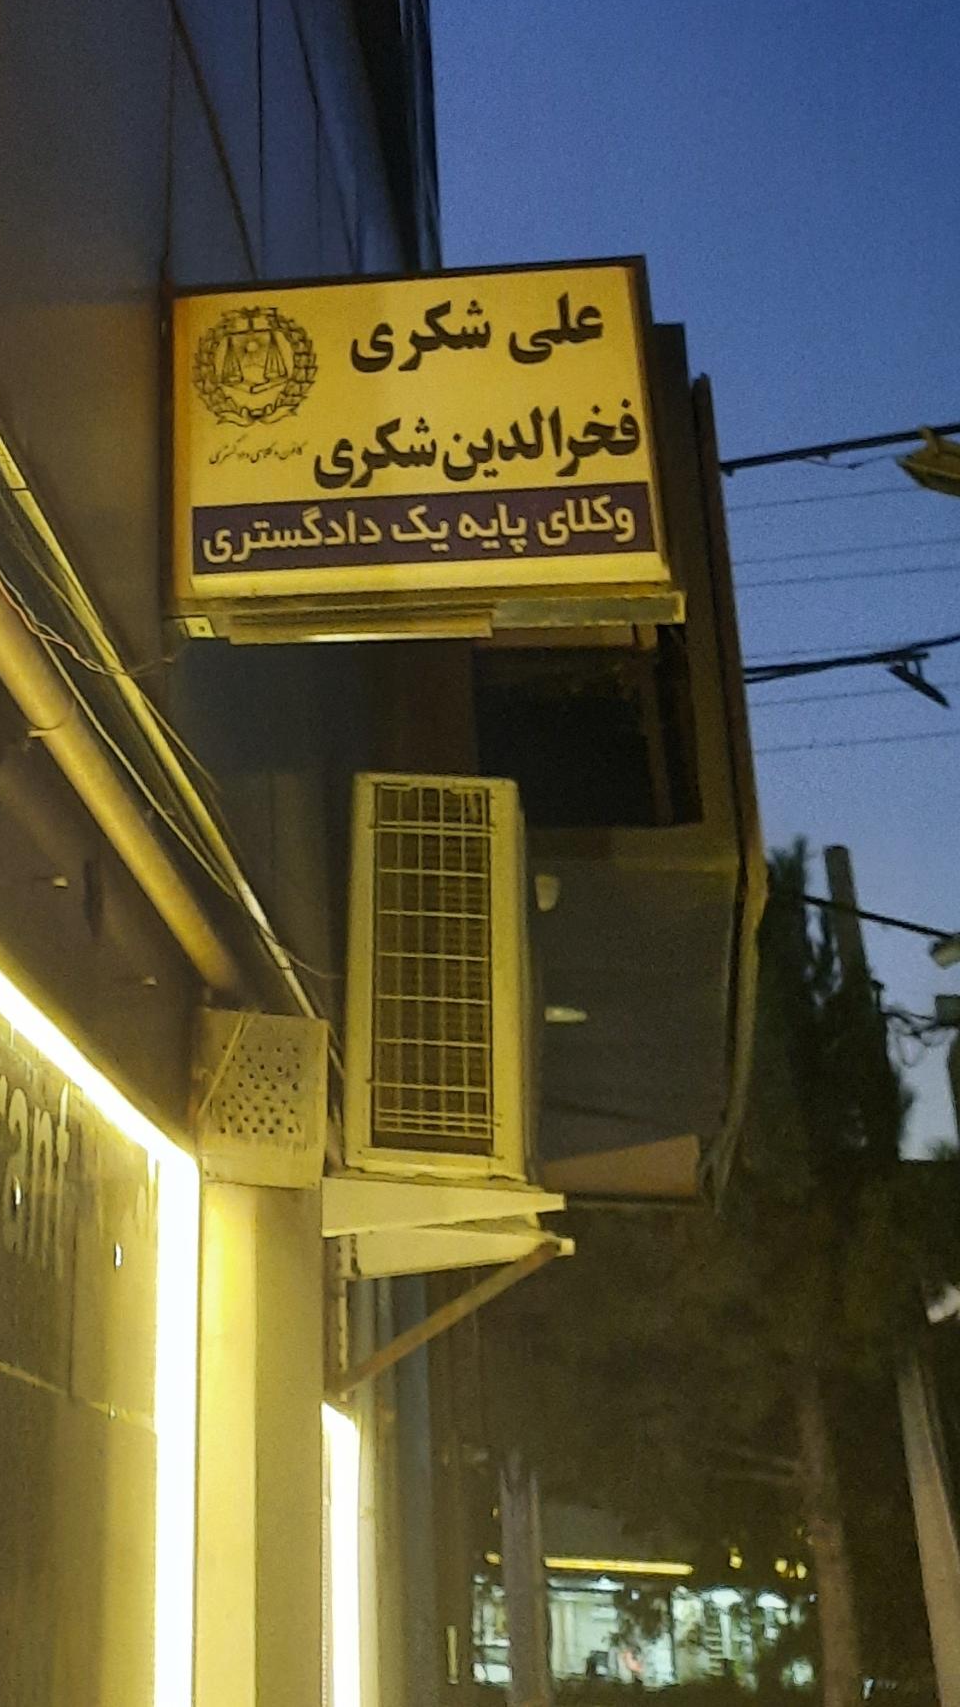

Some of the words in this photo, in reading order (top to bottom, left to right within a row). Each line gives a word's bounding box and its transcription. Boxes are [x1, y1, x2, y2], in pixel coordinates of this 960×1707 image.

[350, 299, 491, 374] شکری
[508, 291, 604, 365] علی
[313, 417, 437, 490] شکری
[442, 398, 641, 482] فخرالدین
[201, 507, 383, 565] دادگستری
[389, 505, 450, 552] یک
[457, 503, 529, 555] پایه
[539, 495, 636, 547] وکلای
